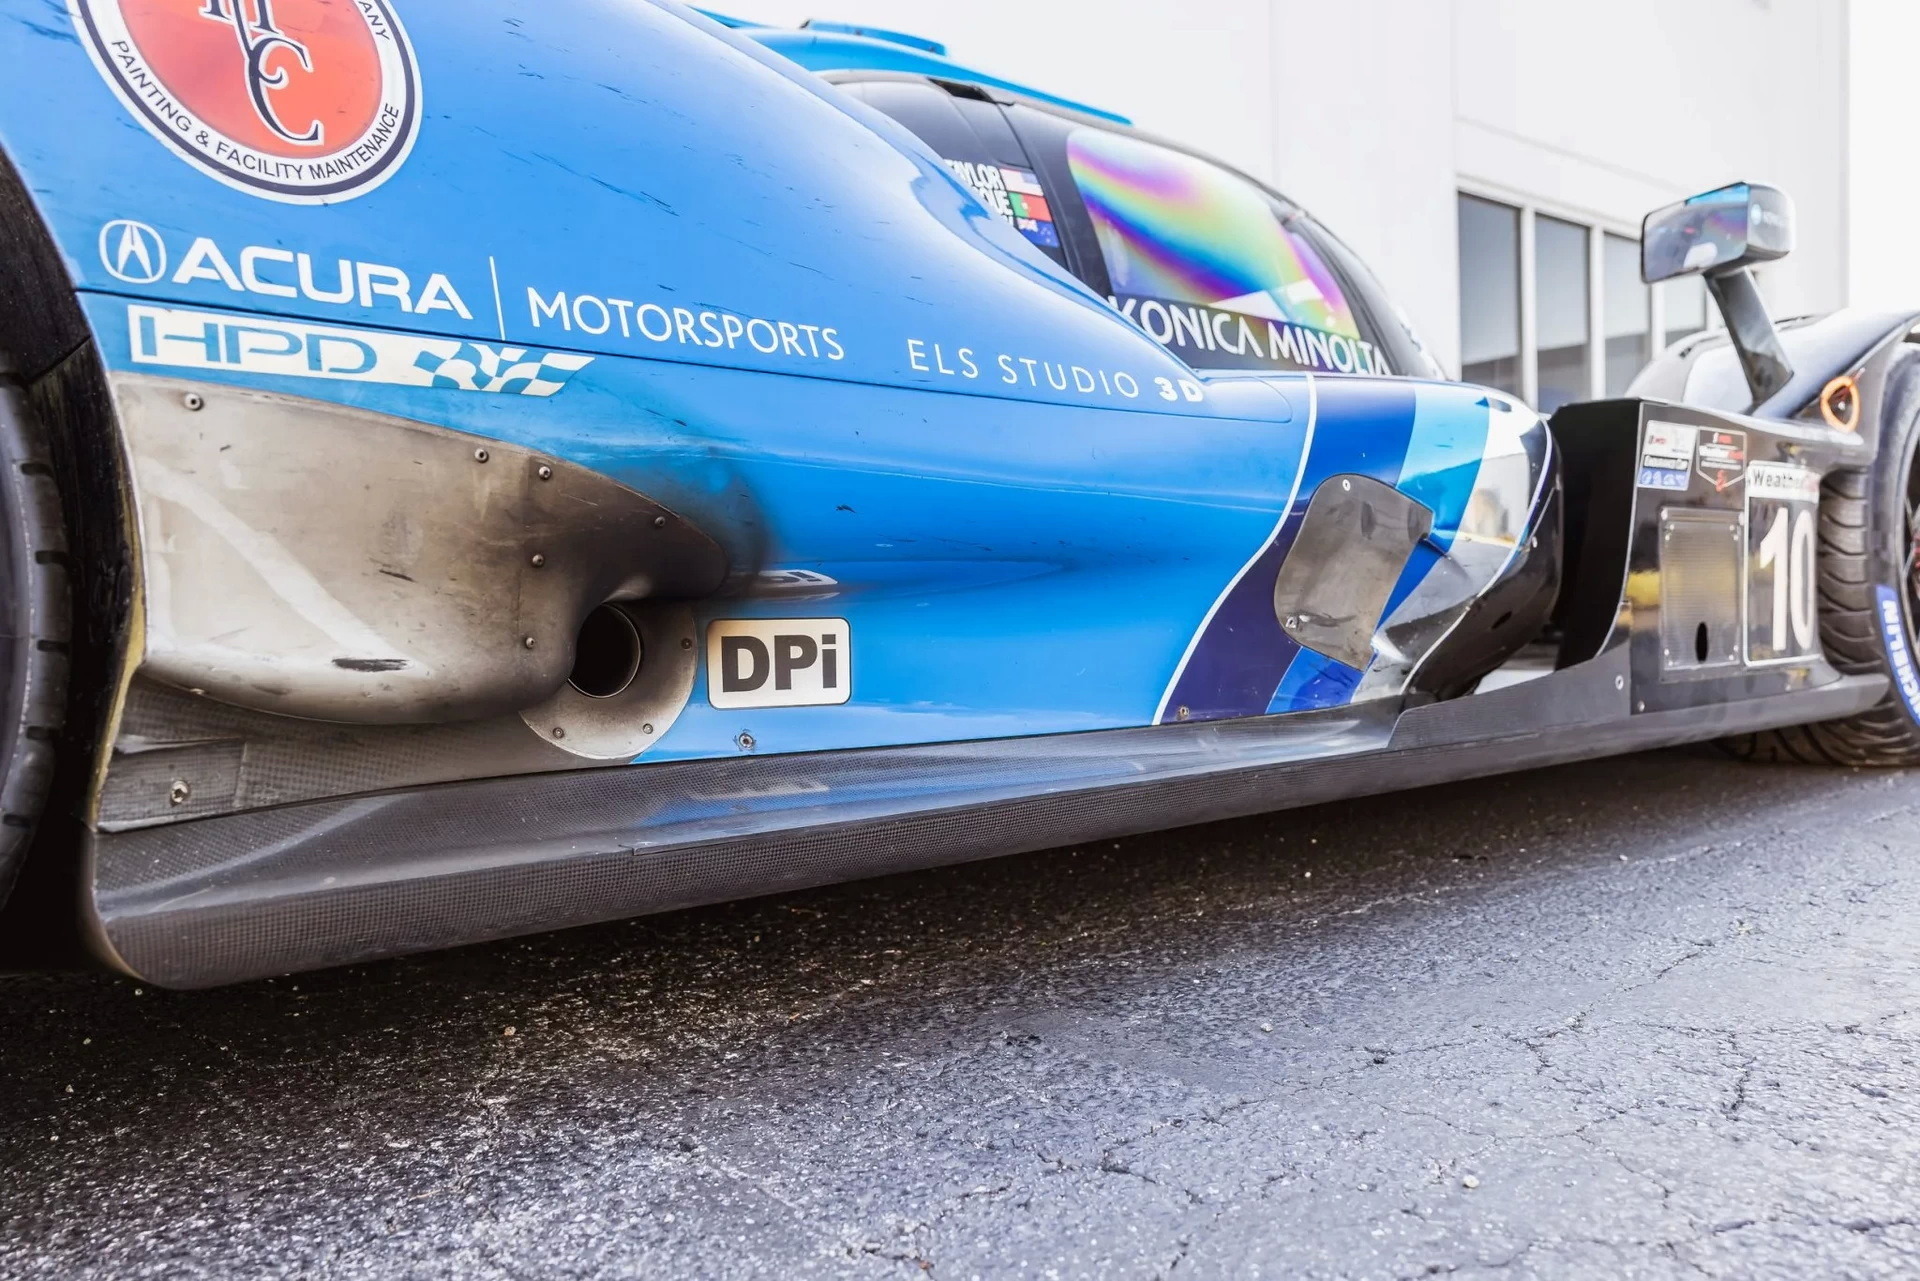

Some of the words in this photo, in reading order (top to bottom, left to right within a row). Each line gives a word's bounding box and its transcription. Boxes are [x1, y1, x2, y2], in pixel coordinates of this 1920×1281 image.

[111, 40, 193, 132] PAINTING
[195, 130, 209, 148] &
[216, 142, 303, 180] FACILITY
[308, 103, 399, 180] MAINTENANCE
[172, 237, 473, 320] ACURA
[527, 287, 846, 361] MOTORSPORTS
[1108, 295, 1263, 358] KONICA
[1267, 321, 1391, 376] MINOLTA
[138, 315, 378, 374] HPD
[907, 338, 979, 379] ELS
[998, 354, 1139, 398] STUDIO
[1154, 376, 1205, 402] 3D
[1760, 507, 1816, 651] 10
[721, 633, 838, 694] DPi
